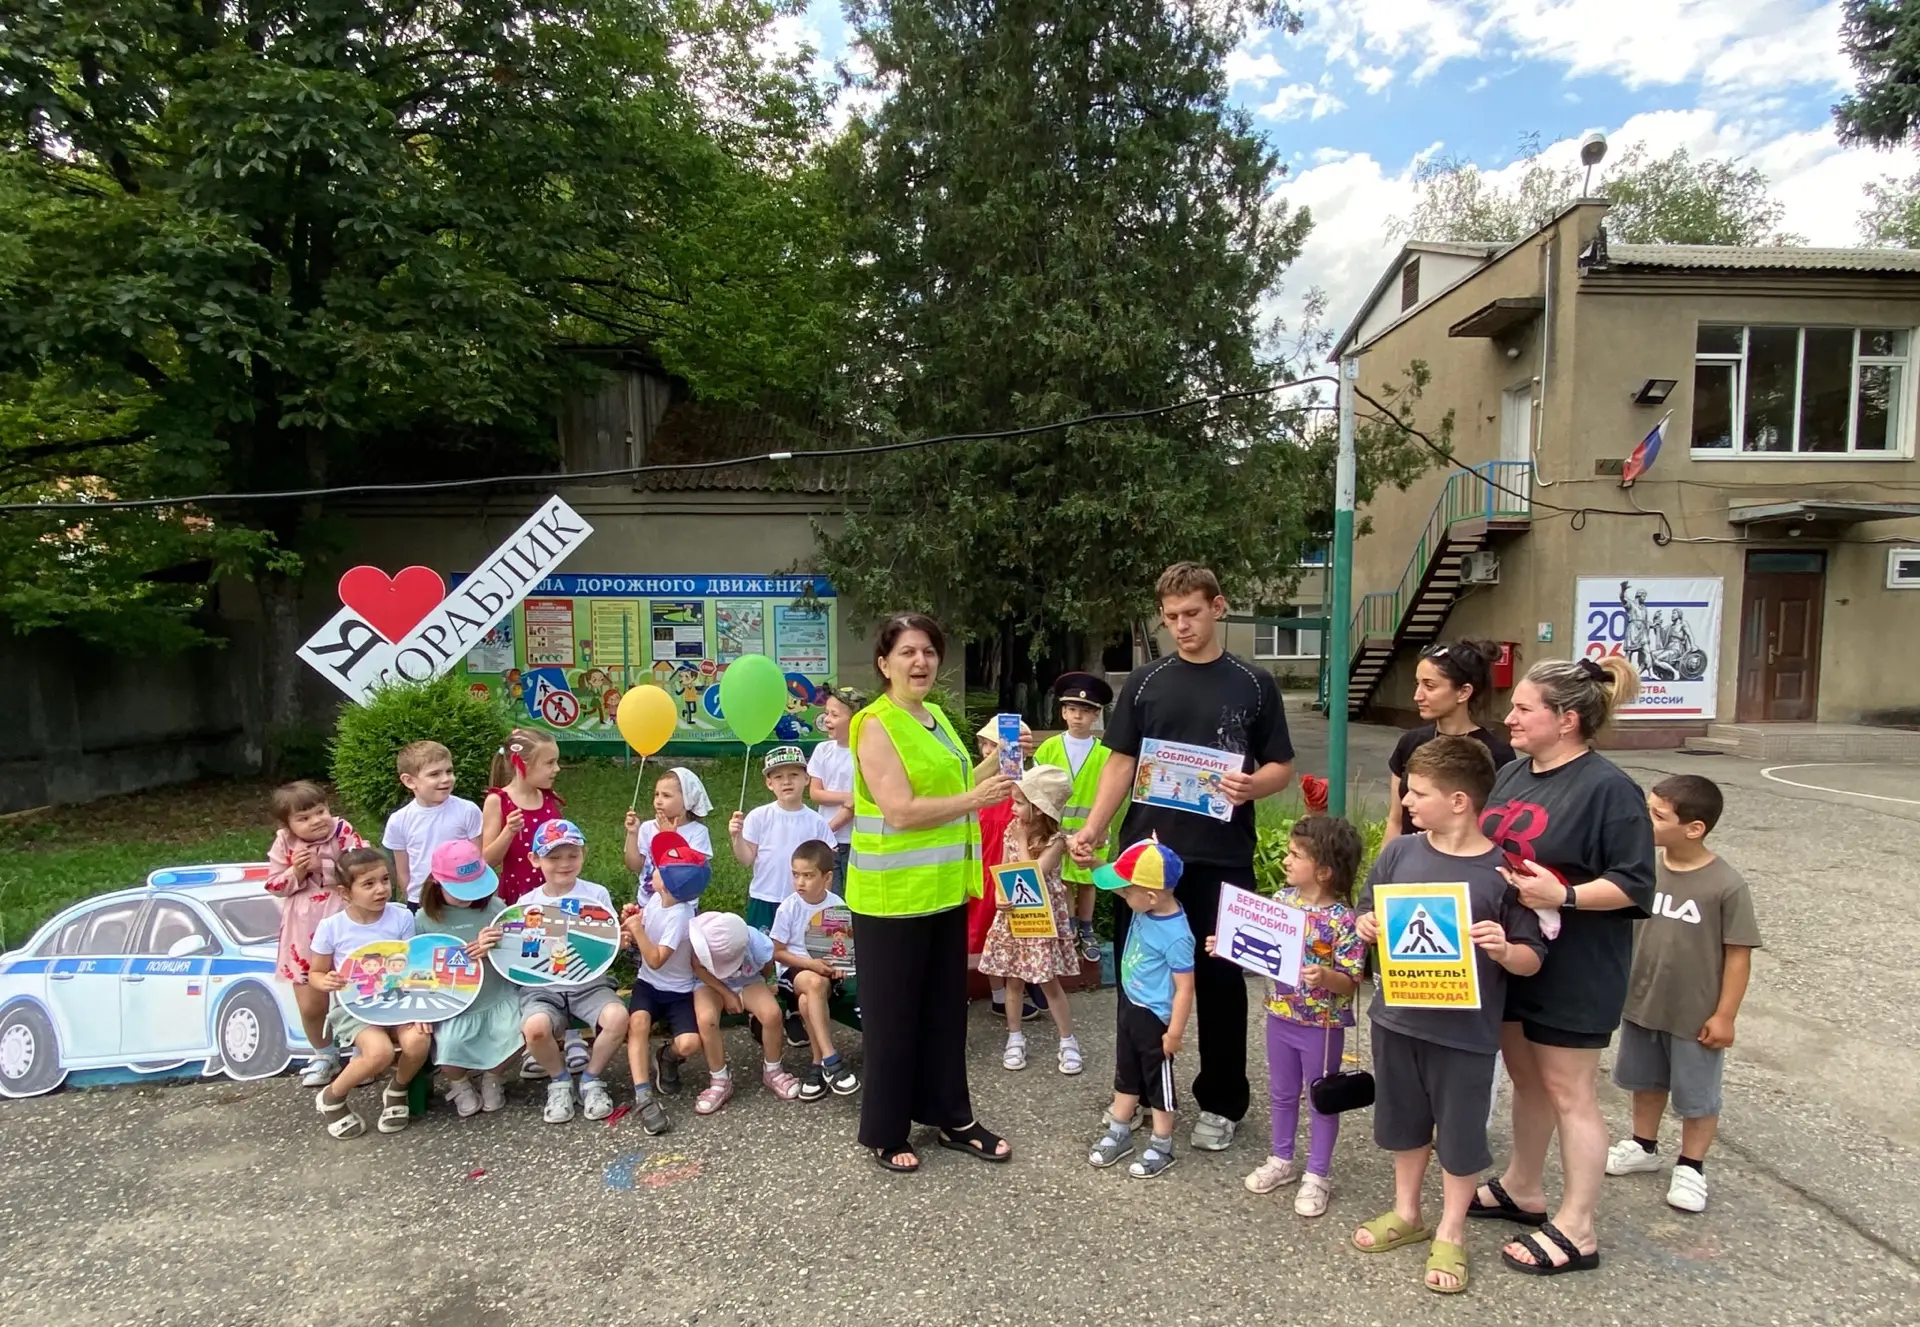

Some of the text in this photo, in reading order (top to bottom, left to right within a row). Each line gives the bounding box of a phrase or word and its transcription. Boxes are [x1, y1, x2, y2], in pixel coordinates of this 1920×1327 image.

[533, 578, 565, 591] ЛА
[575, 578, 695, 594] ДОРОЖНОГО
[1587, 610, 1629, 641] 20
[306, 619, 389, 682] Я
[1641, 685, 1666, 694] СТВА
[1639, 696, 1683, 704] РОССИИ
[1155, 750, 1230, 772] СОБЛЮДАЙТЕ
[1237, 893, 1289, 920] БЕРЕГИСЬ
[1652, 891, 1701, 924] ILA
[1012, 911, 1049, 919] ВОДИТЕЛЬ!
[1227, 903, 1297, 936] АВТОМОБИЛЯ
[77, 960, 97, 973] ДПС
[145, 960, 192, 973] ПОЛИЦИЯ
[1388, 968, 1467, 978] ВОДИТЕЛЬ!
[1390, 980, 1469, 989] ПРОПУСТИ
[1391, 991, 1469, 1001] ПЕШЕХОДА!
